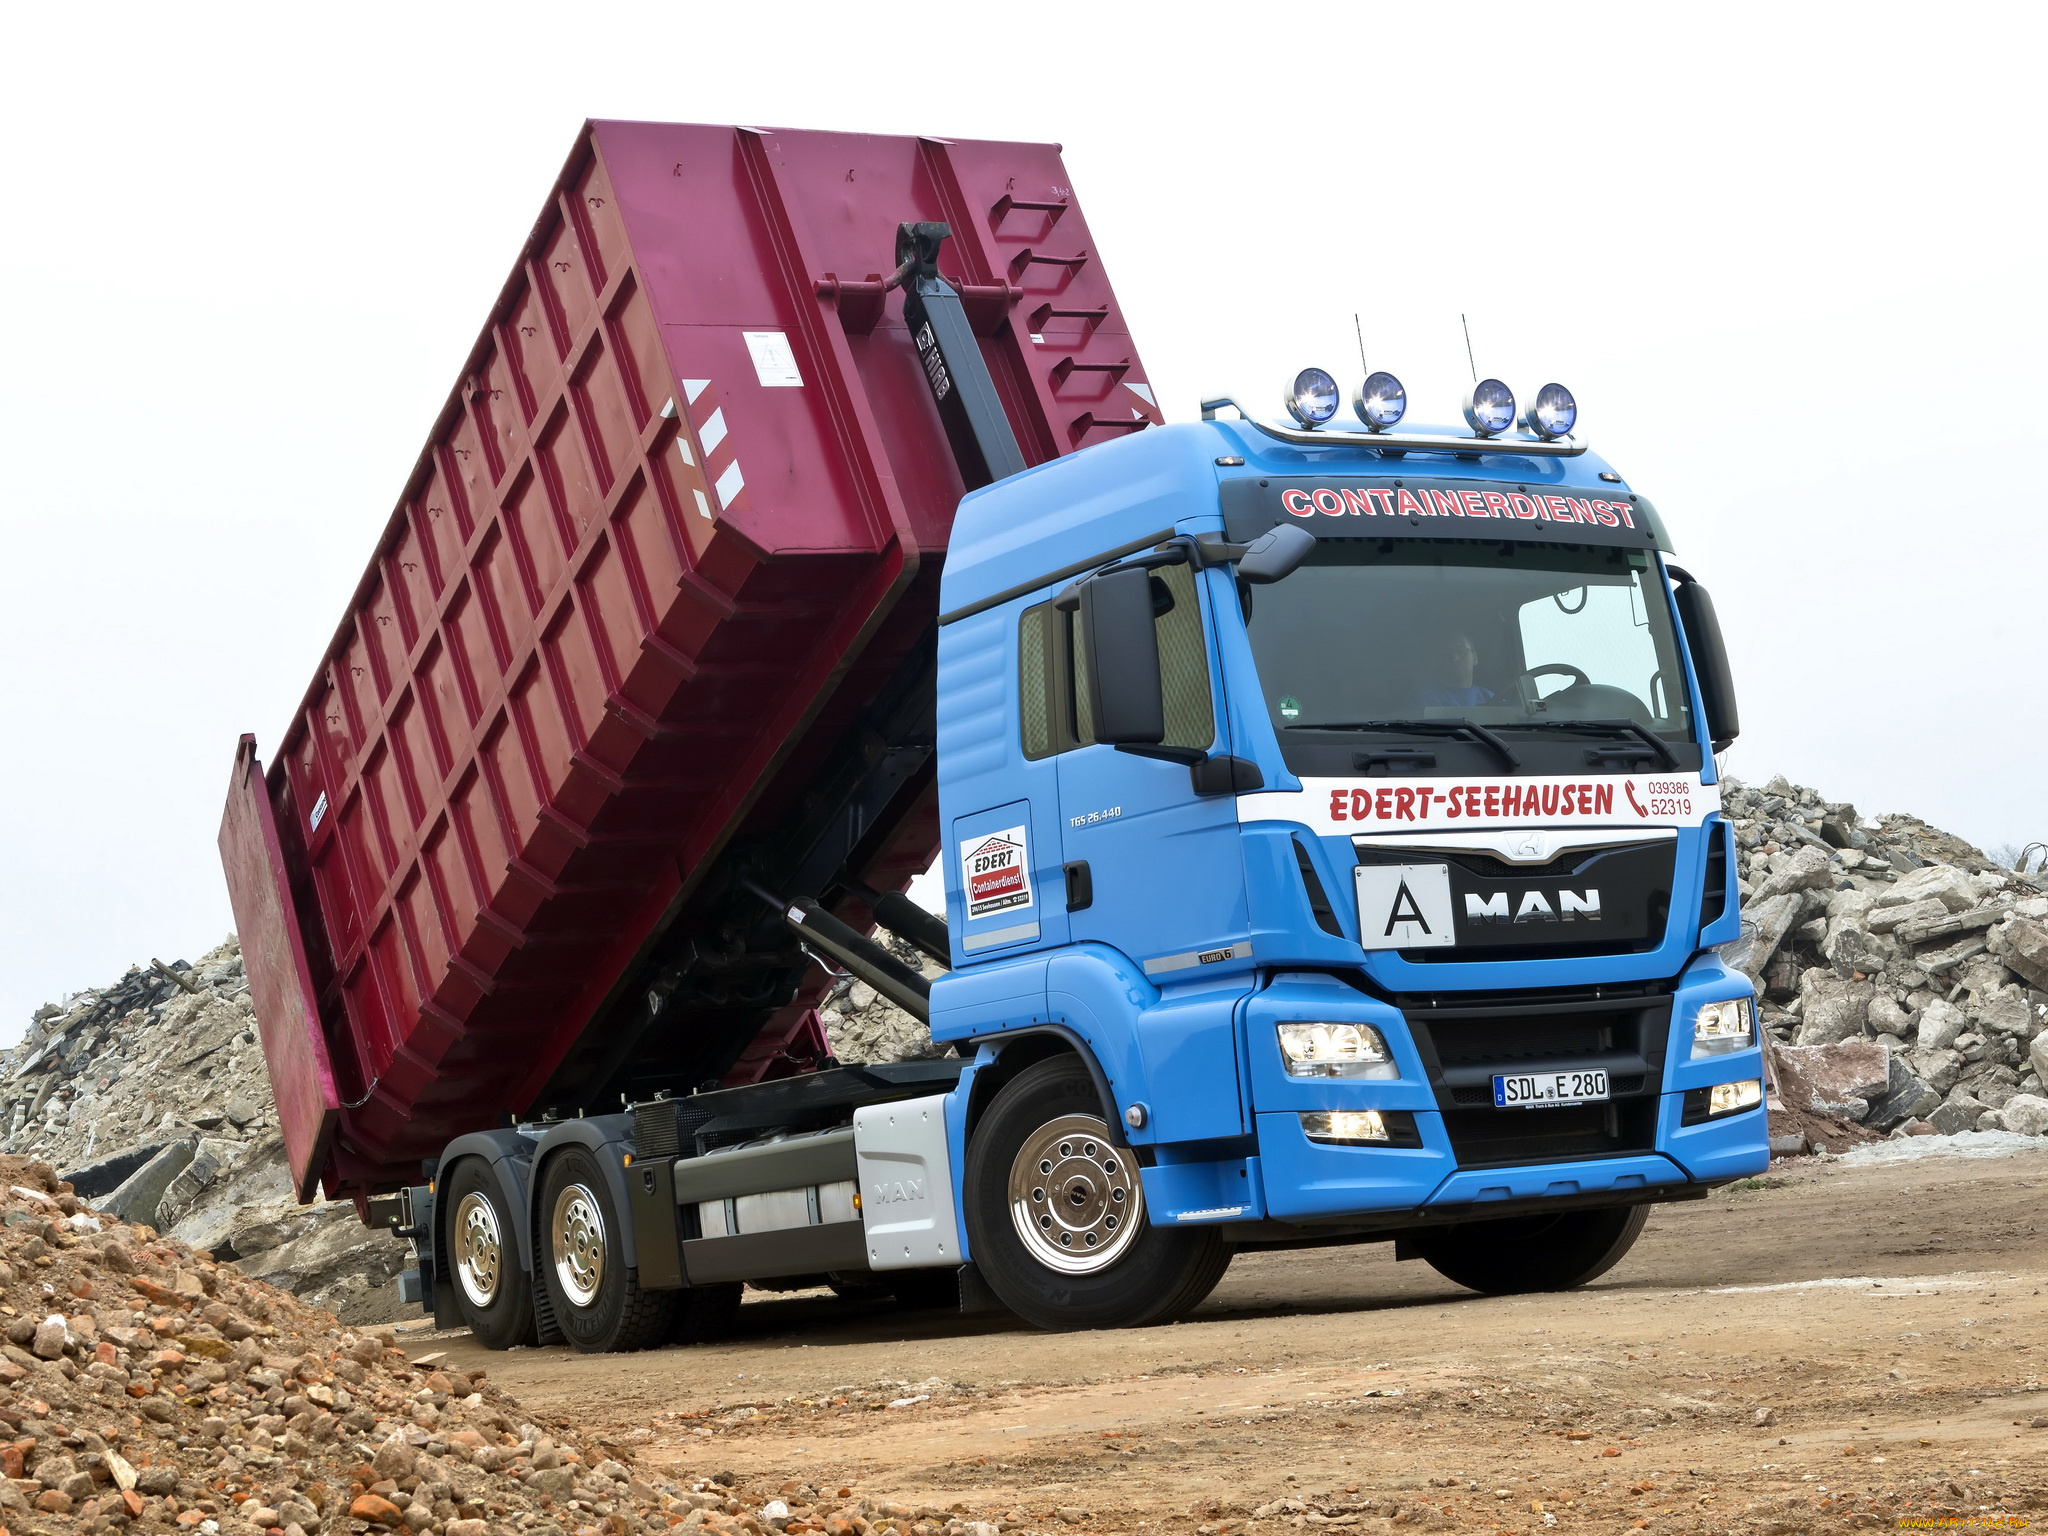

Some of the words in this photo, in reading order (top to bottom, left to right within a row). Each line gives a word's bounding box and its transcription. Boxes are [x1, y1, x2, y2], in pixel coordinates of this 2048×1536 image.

[925, 346, 950, 400] HIAB
[1281, 488, 1635, 530] CONTAINERDIENST
[1648, 781, 1689, 796] 039386
[1329, 783, 1614, 822] EDERT-SEEHAUSEN
[1651, 798, 1692, 816] 52319
[1070, 815, 1086, 828] TGS
[1087, 806, 1122, 824] 26.440
[974, 849, 1014, 873] EDERT
[972, 873, 1021, 894] Containerdienst
[1384, 879, 1433, 936] A
[1464, 889, 1602, 926] MAN
[1201, 953, 1222, 964] EURO
[1224, 948, 1232, 959] 6
[1506, 1077, 1544, 1101] SDL
[1556, 1075, 1569, 1098] E
[1571, 1073, 1606, 1097] 280
[873, 1178, 925, 1204] MAN
